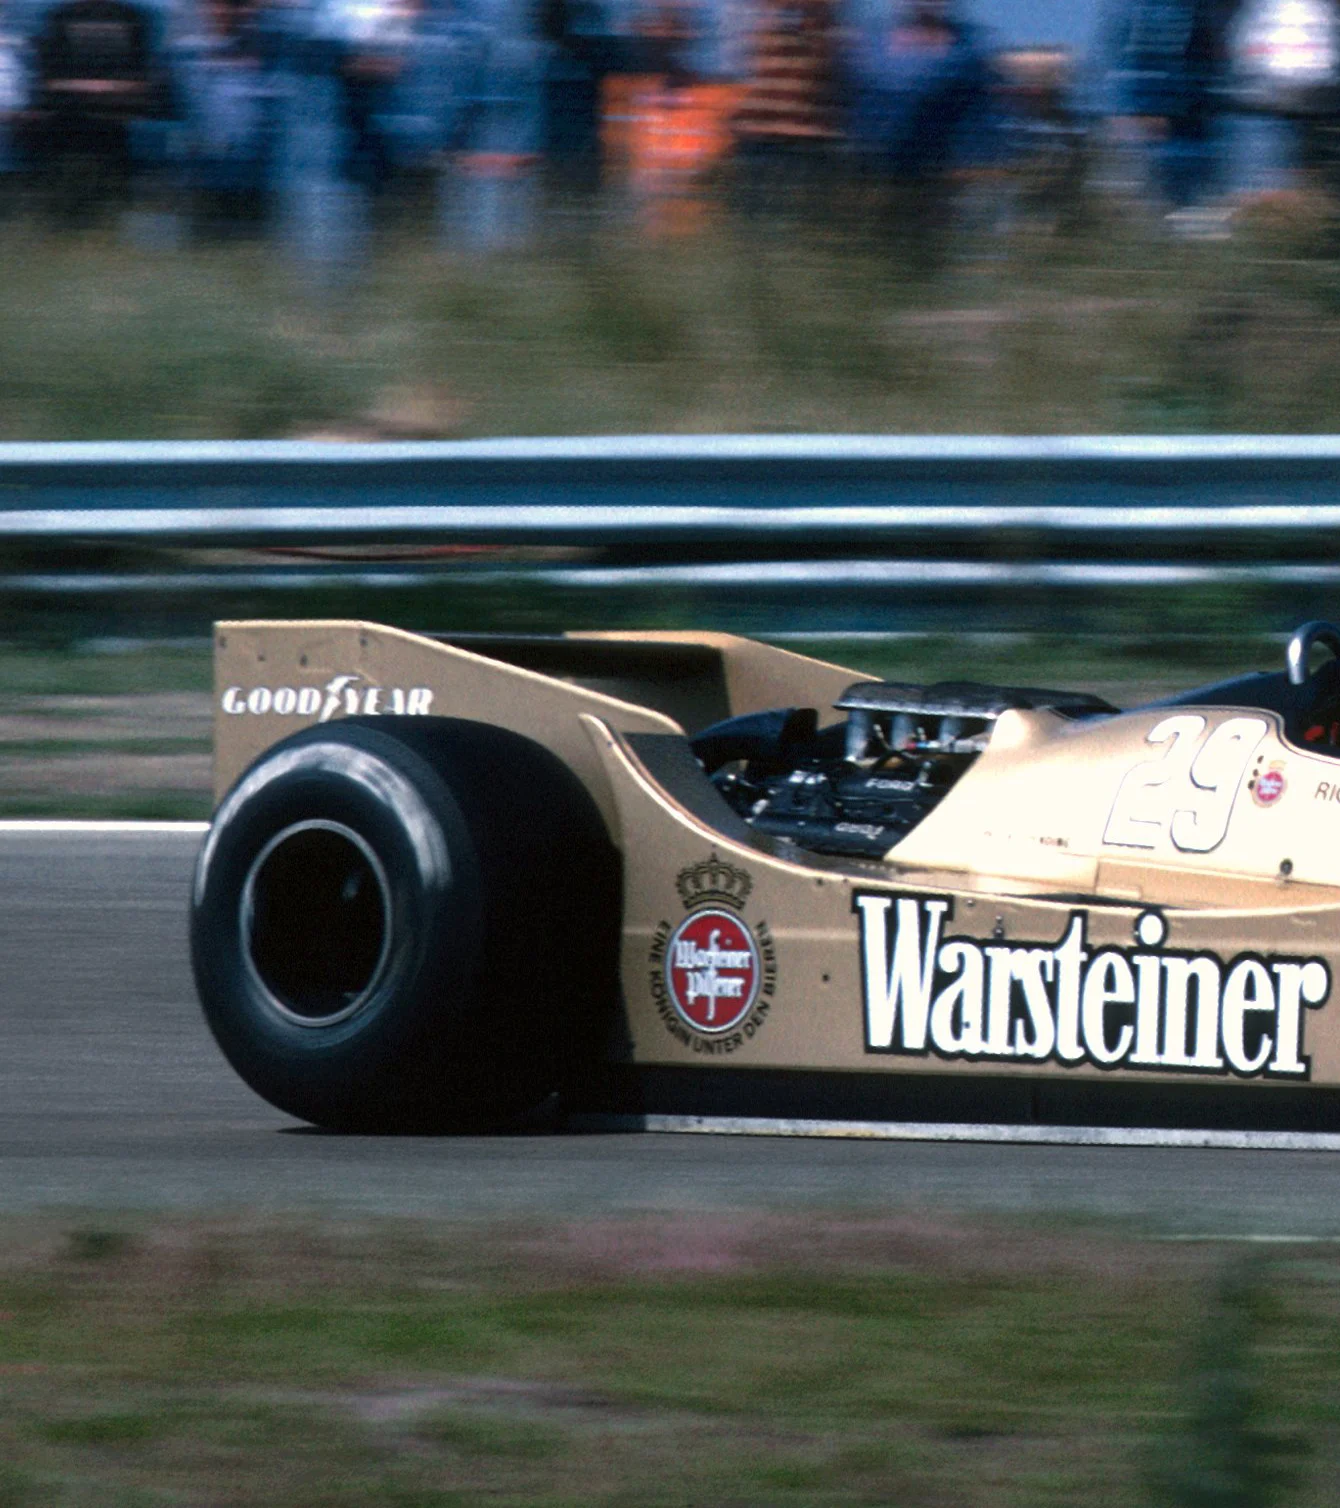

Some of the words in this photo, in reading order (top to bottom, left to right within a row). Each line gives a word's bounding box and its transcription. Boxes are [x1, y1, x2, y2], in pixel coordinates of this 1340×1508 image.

[221, 676, 434, 723] GOODYEAR
[1102, 715, 1268, 854] 29
[855, 892, 1333, 1079] Warsteiner
